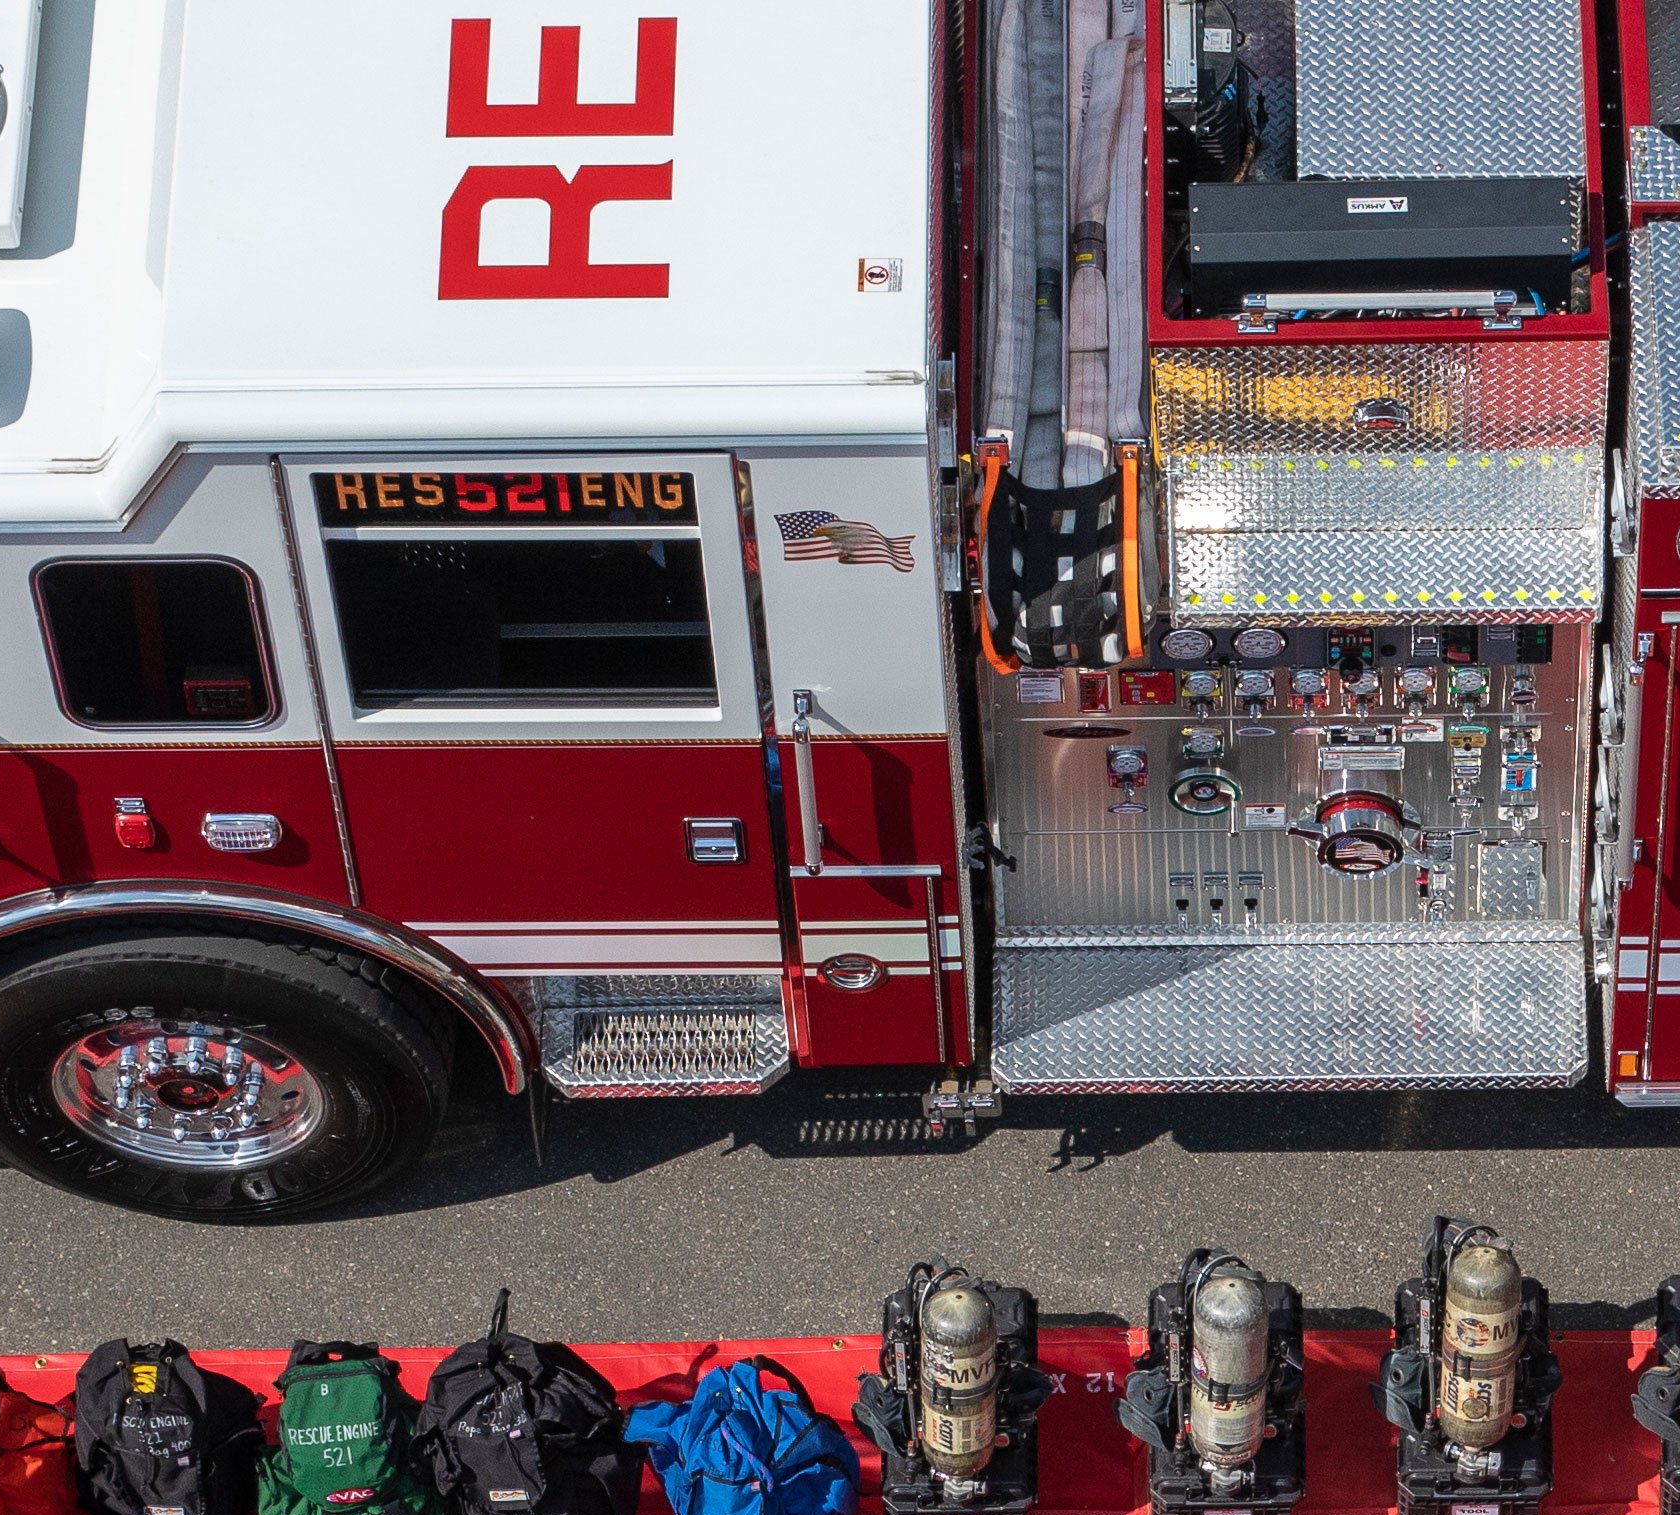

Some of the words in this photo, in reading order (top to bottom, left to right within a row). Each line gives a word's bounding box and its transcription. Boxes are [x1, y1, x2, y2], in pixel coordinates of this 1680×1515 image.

[437, 16, 678, 300] RE
[1350, 202, 1386, 210] AMKUS
[334, 472, 446, 511] RES
[454, 472, 573, 514] 521
[579, 472, 685, 511] ENG
[320, 1383, 329, 1397] B
[1086, 1371, 1116, 1393] 12
[288, 1421, 335, 1447] RESCUE
[335, 1417, 382, 1442] ENGINE
[938, 1416, 954, 1451] SCOTT
[322, 1446, 354, 1467] 521
[325, 1488, 375, 1505] EVAC
